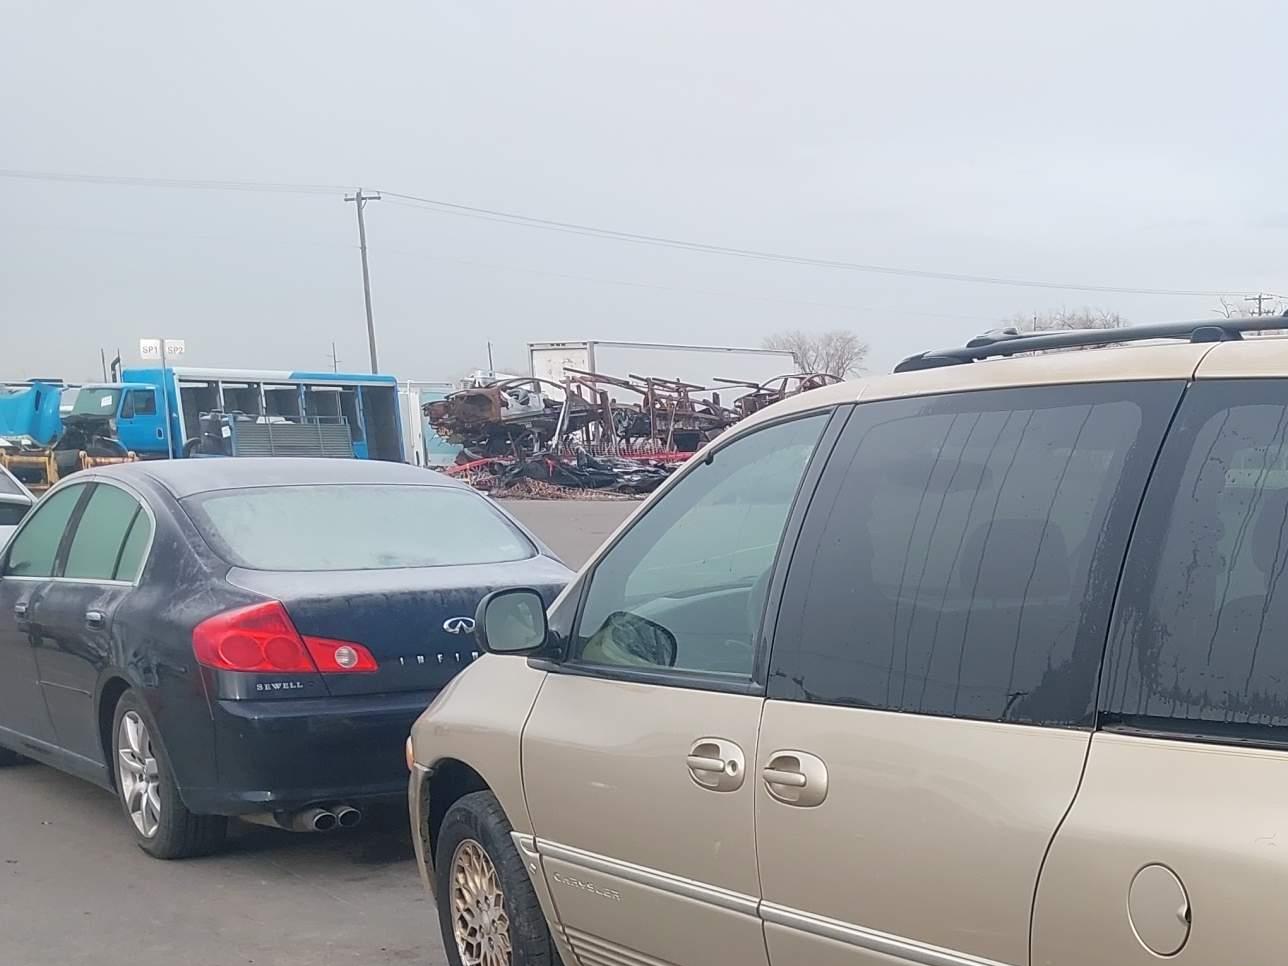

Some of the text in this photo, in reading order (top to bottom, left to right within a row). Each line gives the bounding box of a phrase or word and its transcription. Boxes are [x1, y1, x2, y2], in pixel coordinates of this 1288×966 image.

[143, 345, 158, 354] SP1
[167, 345, 184, 355] SP2
[400, 651, 480, 665] INFIN
[256, 681, 304, 692] SEWELL
